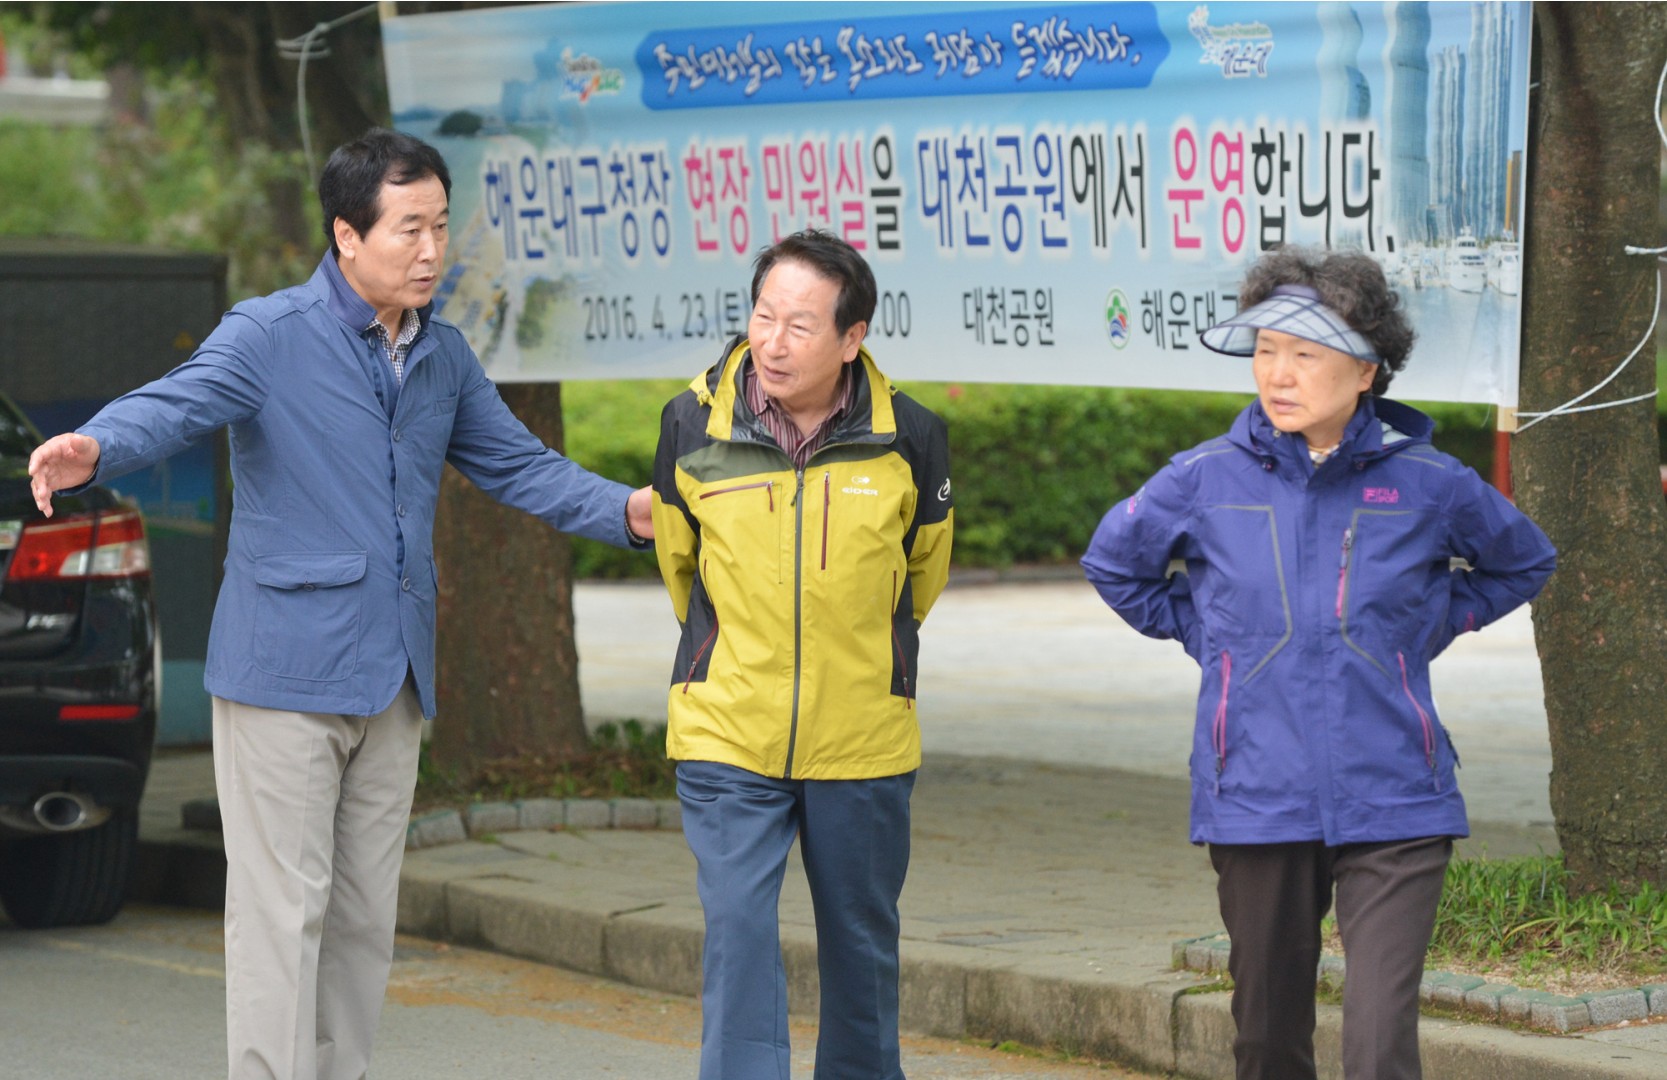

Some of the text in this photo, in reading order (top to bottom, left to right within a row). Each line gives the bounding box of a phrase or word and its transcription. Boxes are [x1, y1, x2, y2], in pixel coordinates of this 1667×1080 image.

[784, 36, 838, 89] 작은
[836, 26, 924, 92] 목소리도
[924, 28, 1002, 78] 귀담아
[484, 127, 1396, 260] 해운대구청장 현장 민원실을 대천공원에서 운영합니다.
[582, 295, 645, 341] 2016.
[652, 294, 674, 341] 4.
[962, 286, 1055, 347] 대천공원
